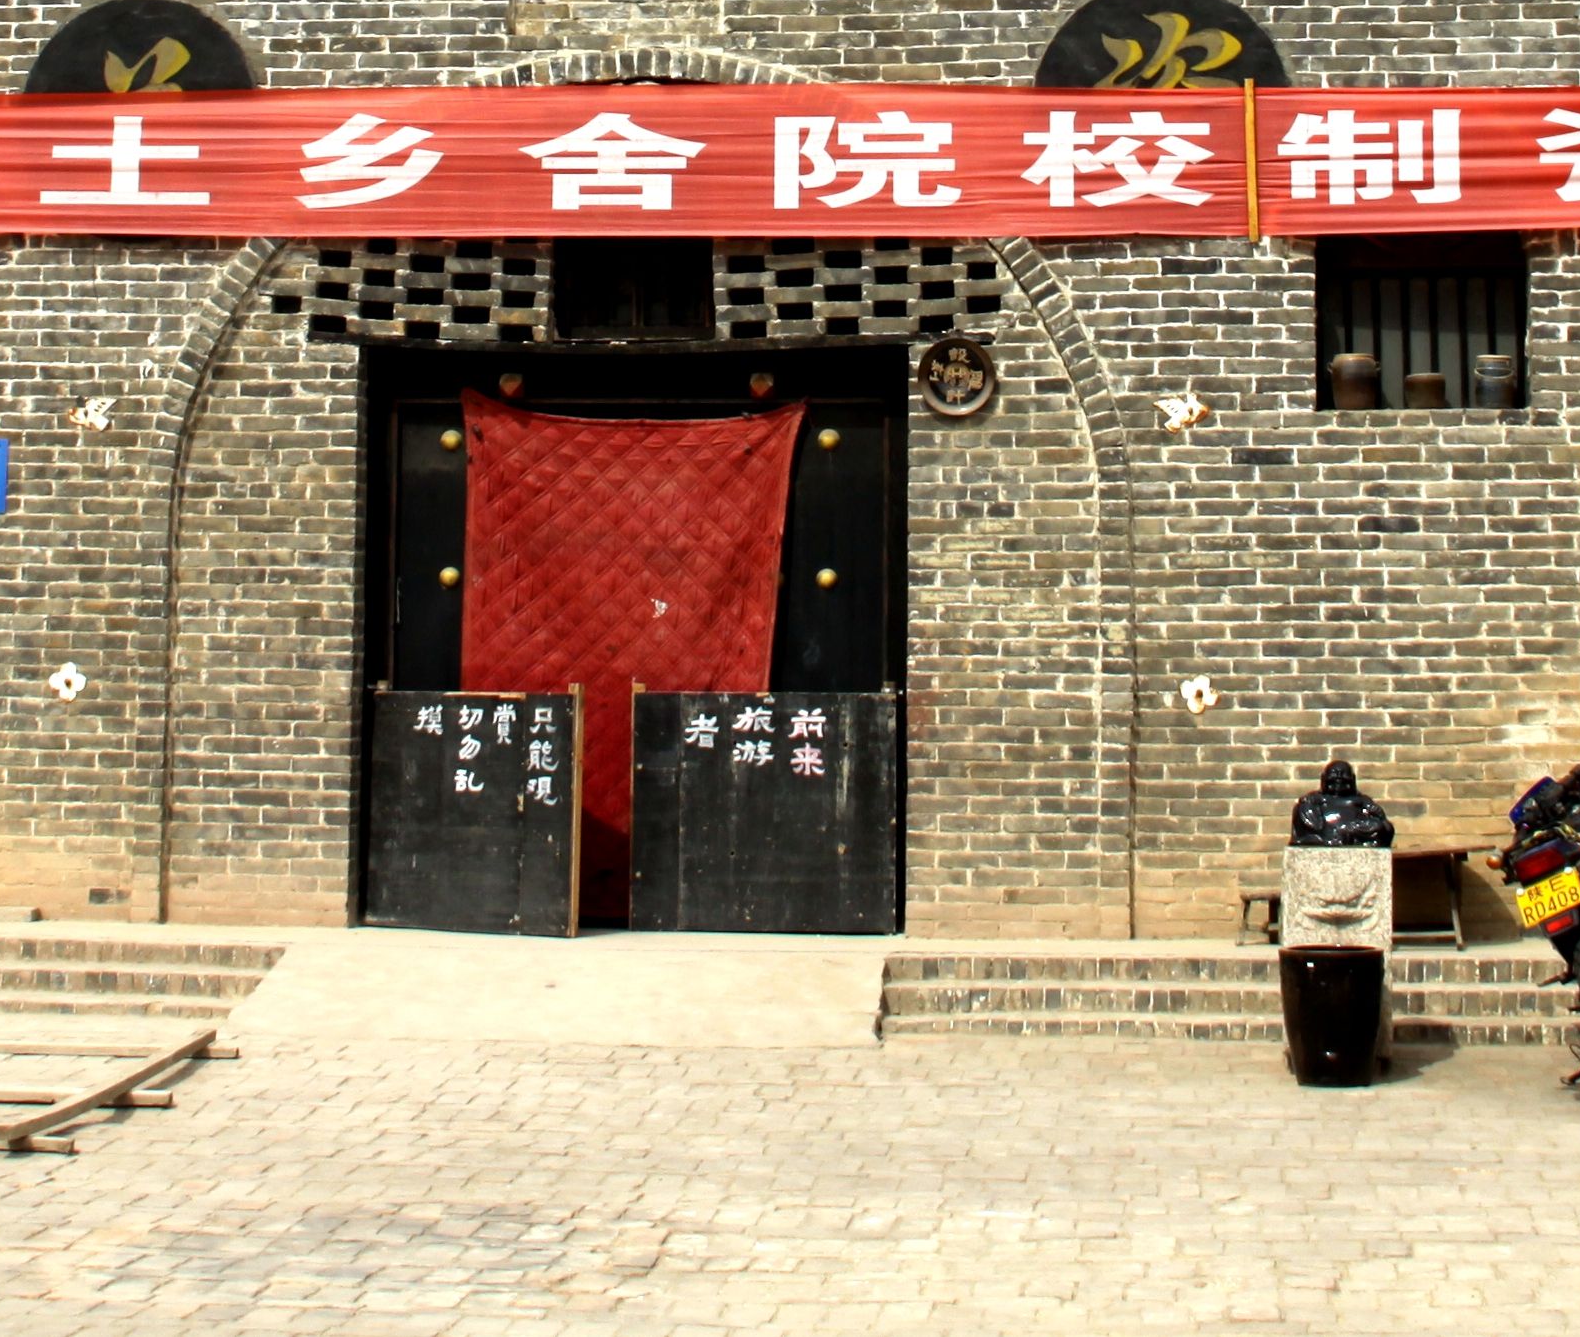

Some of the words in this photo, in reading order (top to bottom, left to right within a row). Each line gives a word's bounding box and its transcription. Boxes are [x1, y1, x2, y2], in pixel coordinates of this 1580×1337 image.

[413, 704, 444, 736] 摸
[684, 713, 720, 749] 者
[732, 706, 776, 767] 旅游
[788, 707, 827, 776] 前来
[453, 704, 485, 793] 切勿乱
[1523, 886, 1580, 924] RD408
